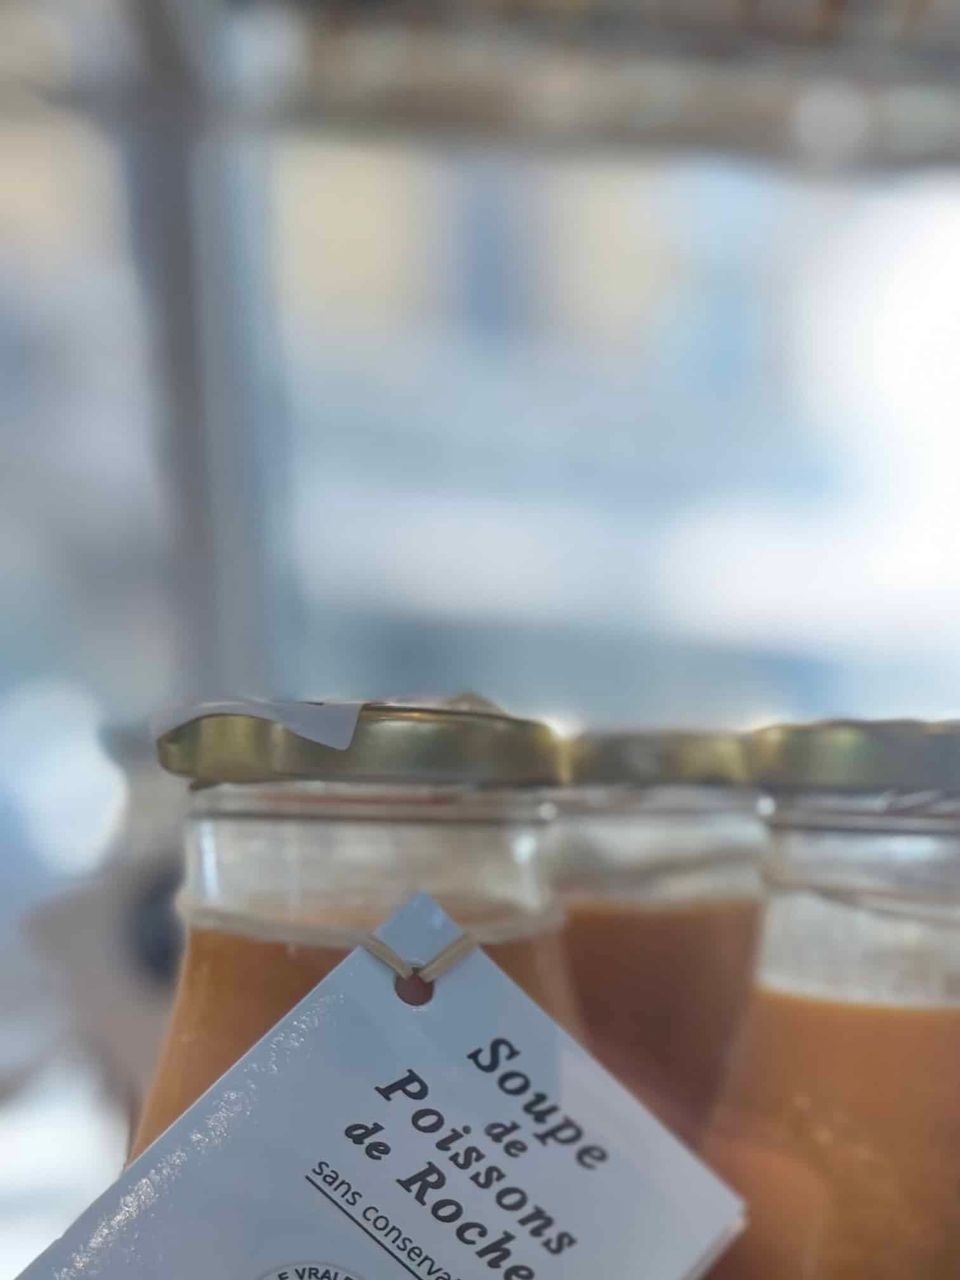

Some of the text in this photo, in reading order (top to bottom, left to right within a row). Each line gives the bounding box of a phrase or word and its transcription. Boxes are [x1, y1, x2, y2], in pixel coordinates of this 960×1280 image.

[467, 1037, 610, 1171] Soupe
[343, 1121, 392, 1162] de
[374, 1068, 577, 1257] Poissons
[484, 1119, 529, 1159] de
[310, 1159, 363, 1207] sans
